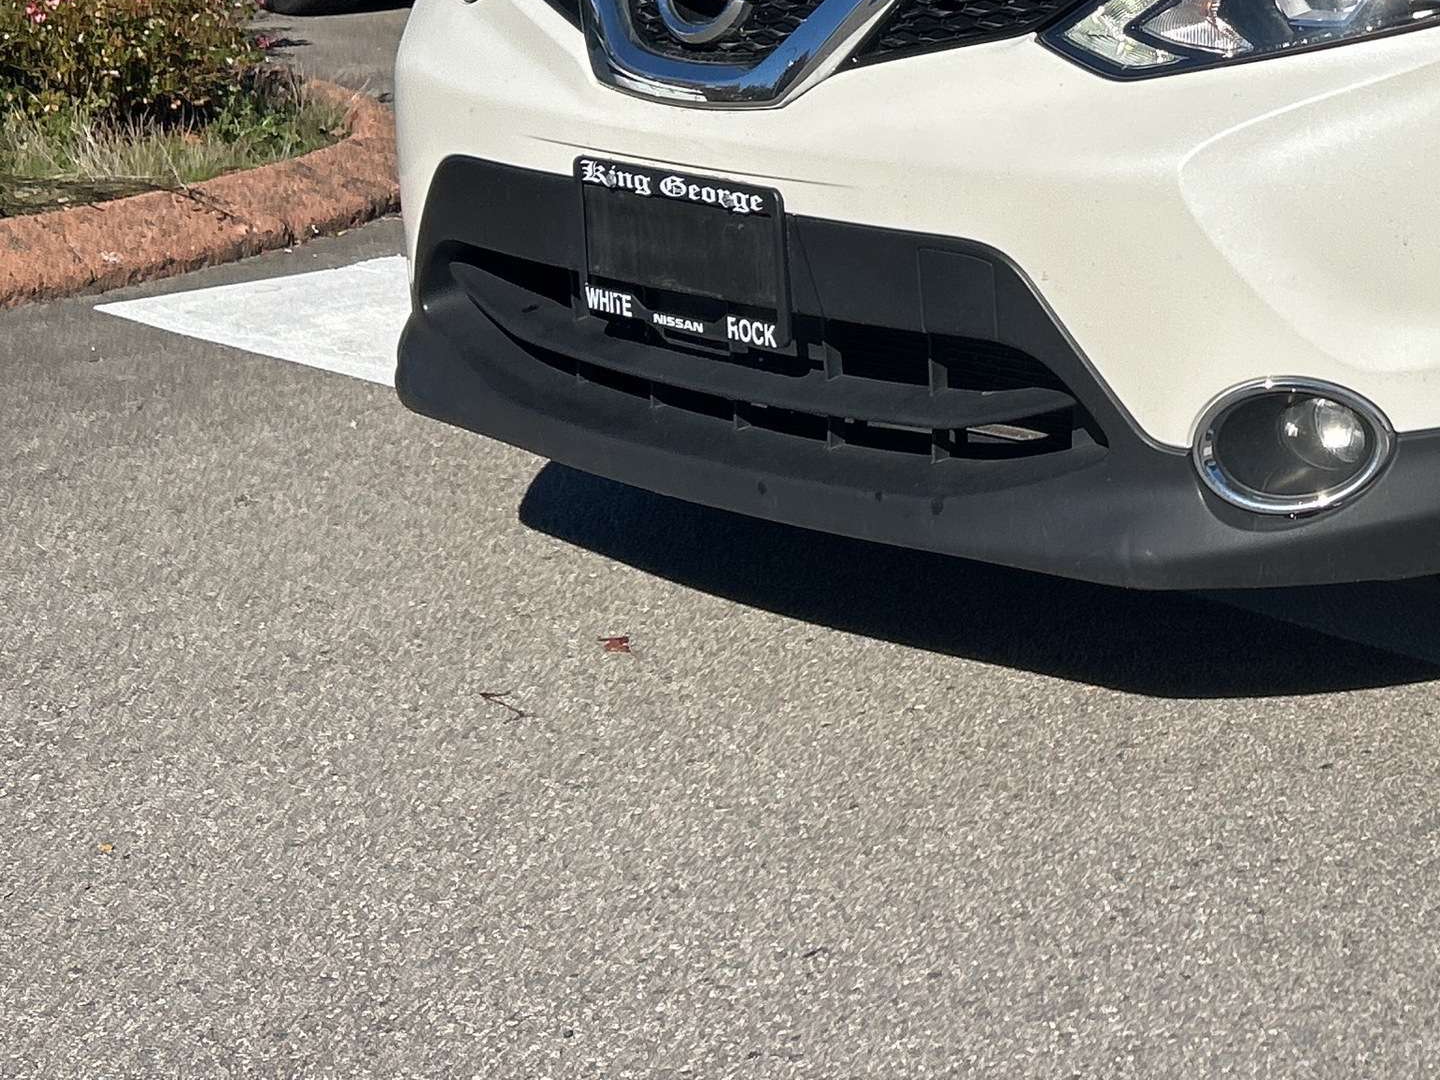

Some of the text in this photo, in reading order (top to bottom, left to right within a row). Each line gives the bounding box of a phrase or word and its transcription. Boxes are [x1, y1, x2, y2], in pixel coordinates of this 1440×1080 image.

[580, 159, 764, 213] King George
[585, 285, 777, 348] WHITE ROCK
[653, 313, 704, 333] NISSAN
